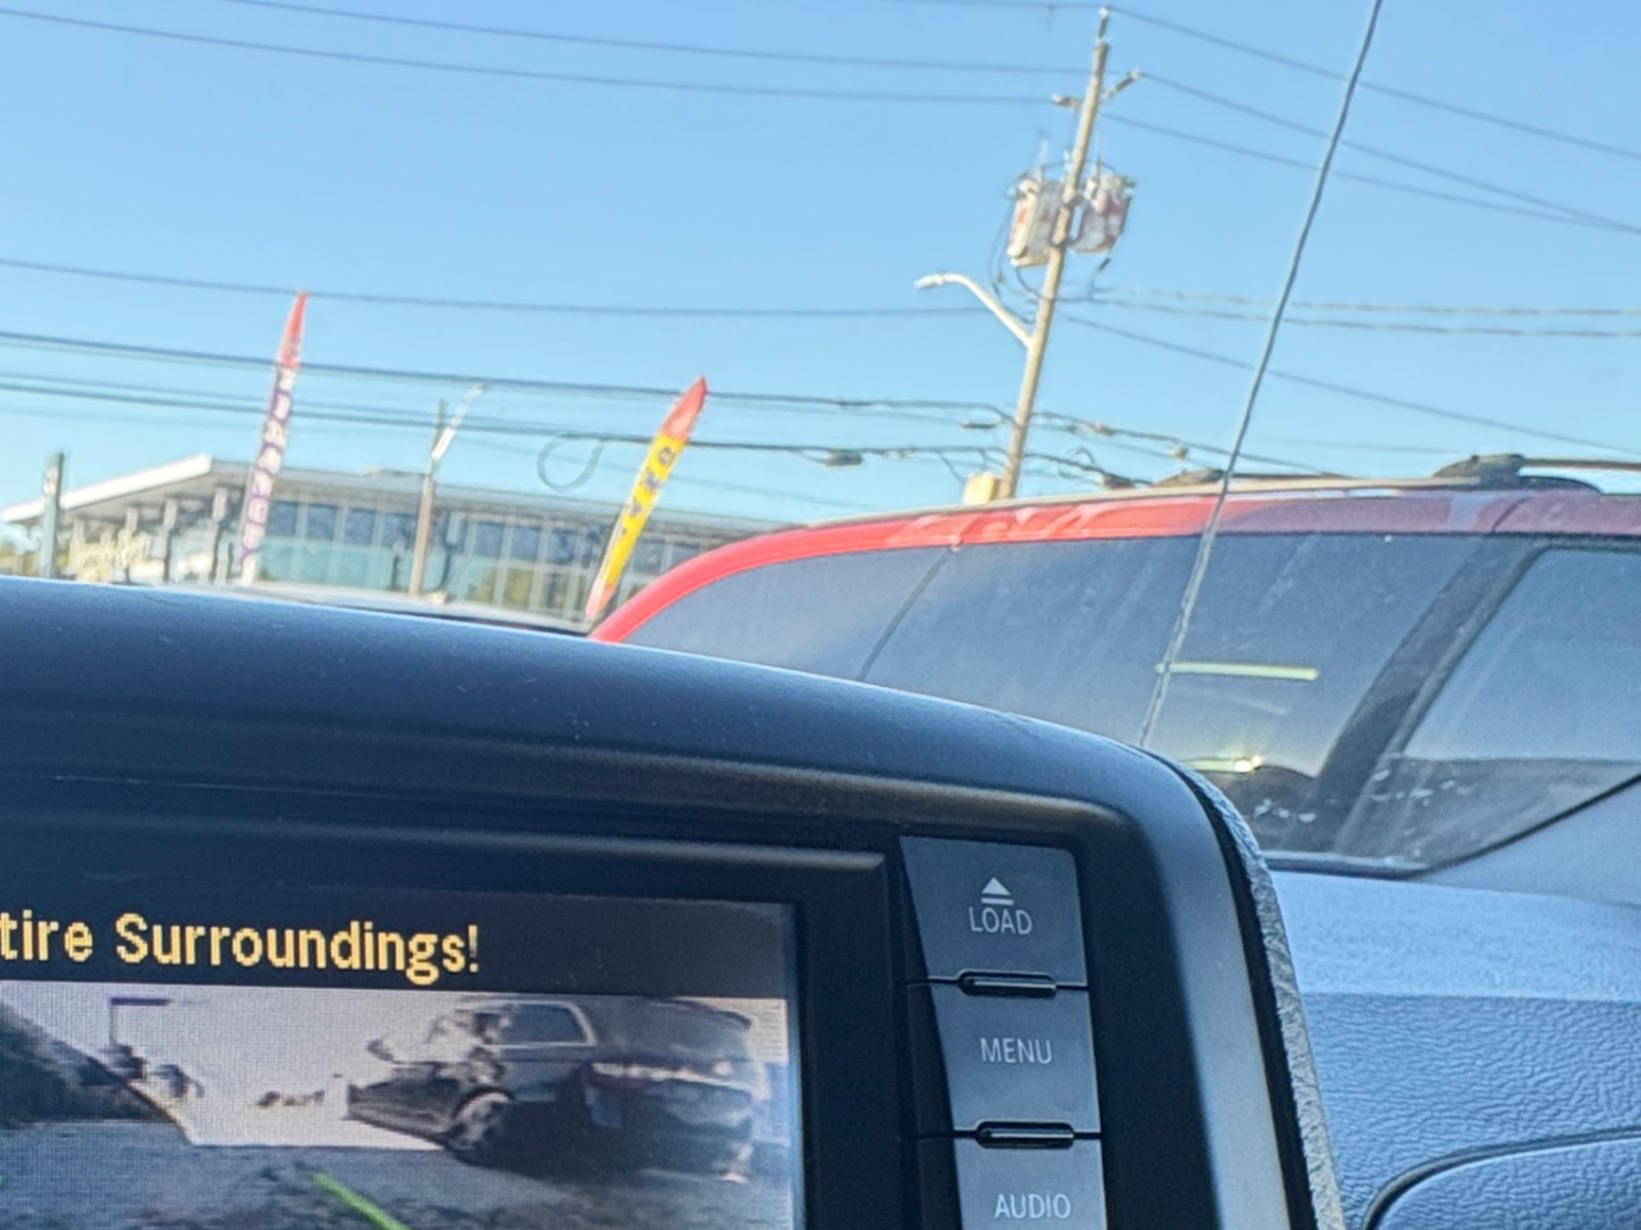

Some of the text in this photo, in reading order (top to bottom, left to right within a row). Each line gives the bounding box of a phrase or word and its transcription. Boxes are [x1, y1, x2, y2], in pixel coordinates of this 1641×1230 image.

[968, 906, 1034, 935] LOAD
[114, 911, 480, 986] Surroundings!
[979, 1036, 1053, 1065] MENU
[994, 1192, 1072, 1220] AUDIO
